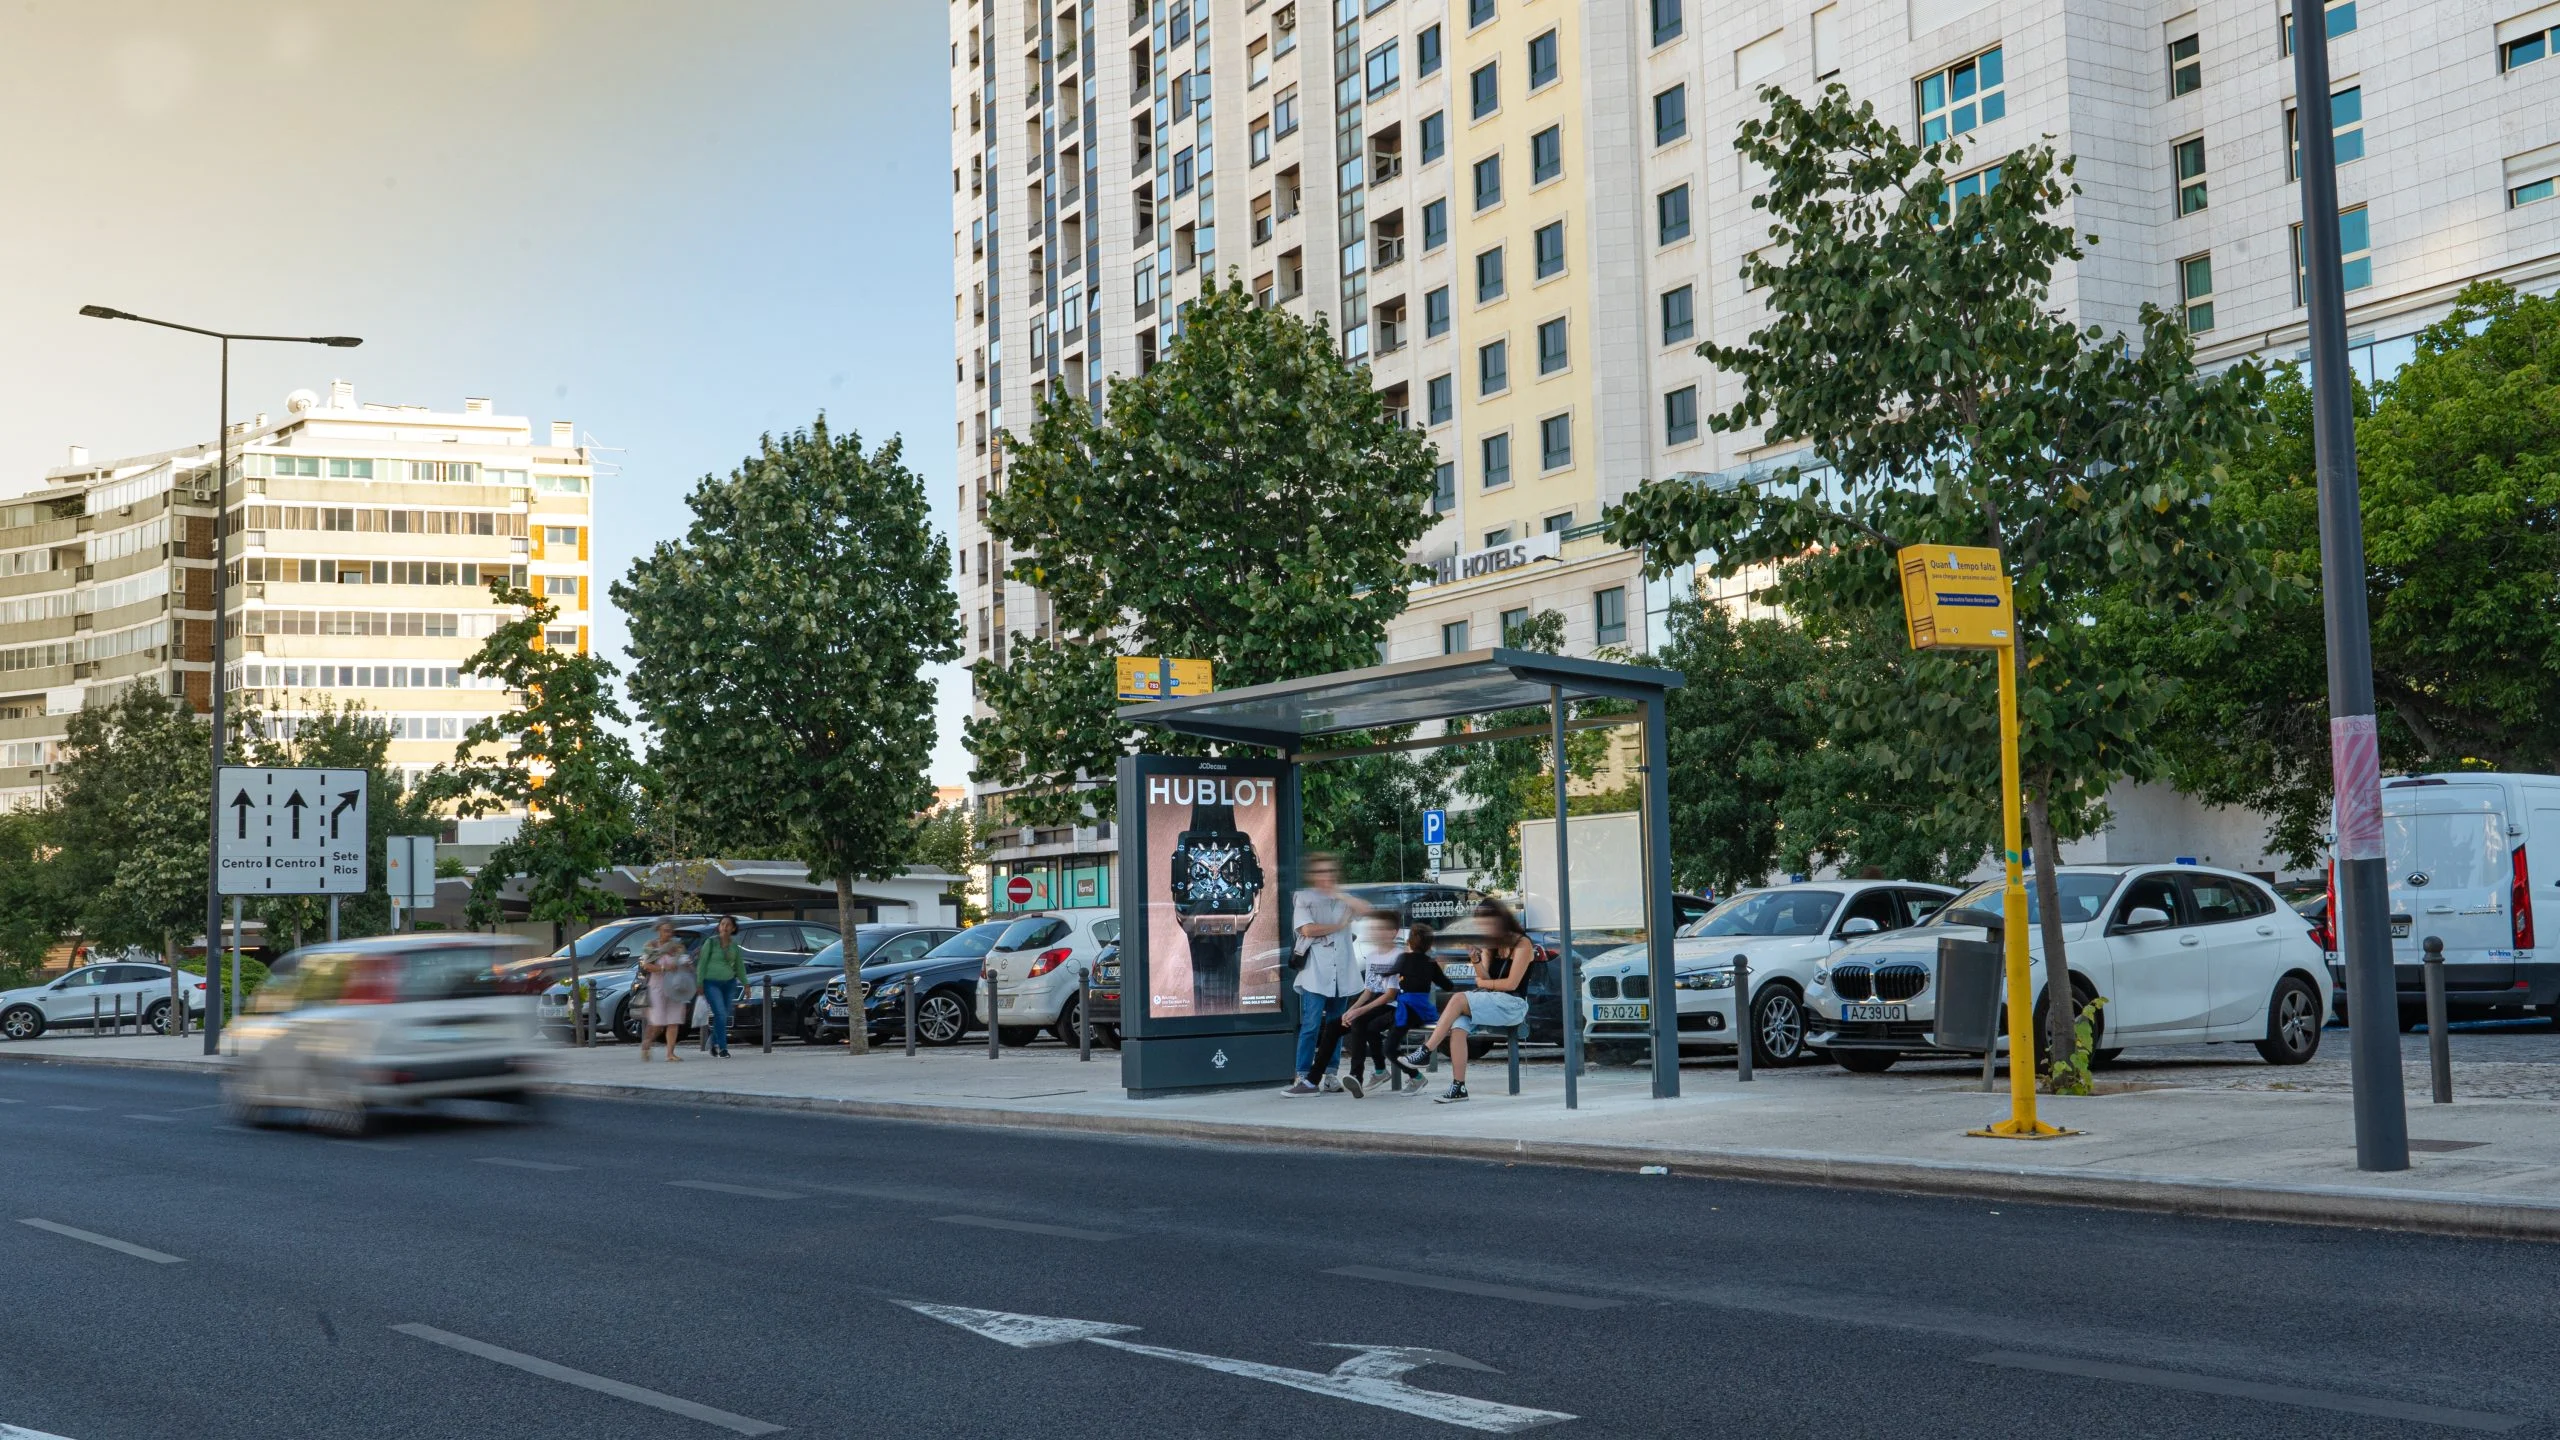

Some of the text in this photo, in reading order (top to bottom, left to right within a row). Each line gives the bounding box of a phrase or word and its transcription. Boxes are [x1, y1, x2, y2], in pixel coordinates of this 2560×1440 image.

[1463, 545, 1526, 578] HOTELS
[1930, 559, 1996, 571] Quant tempo falta
[1150, 778, 1273, 806] HUBLOT
[1428, 814, 1440, 841] P
[333, 852, 359, 861] Sete
[222, 859, 263, 868] Centro
[275, 859, 316, 868] Centro
[333, 865, 358, 874] Rios
